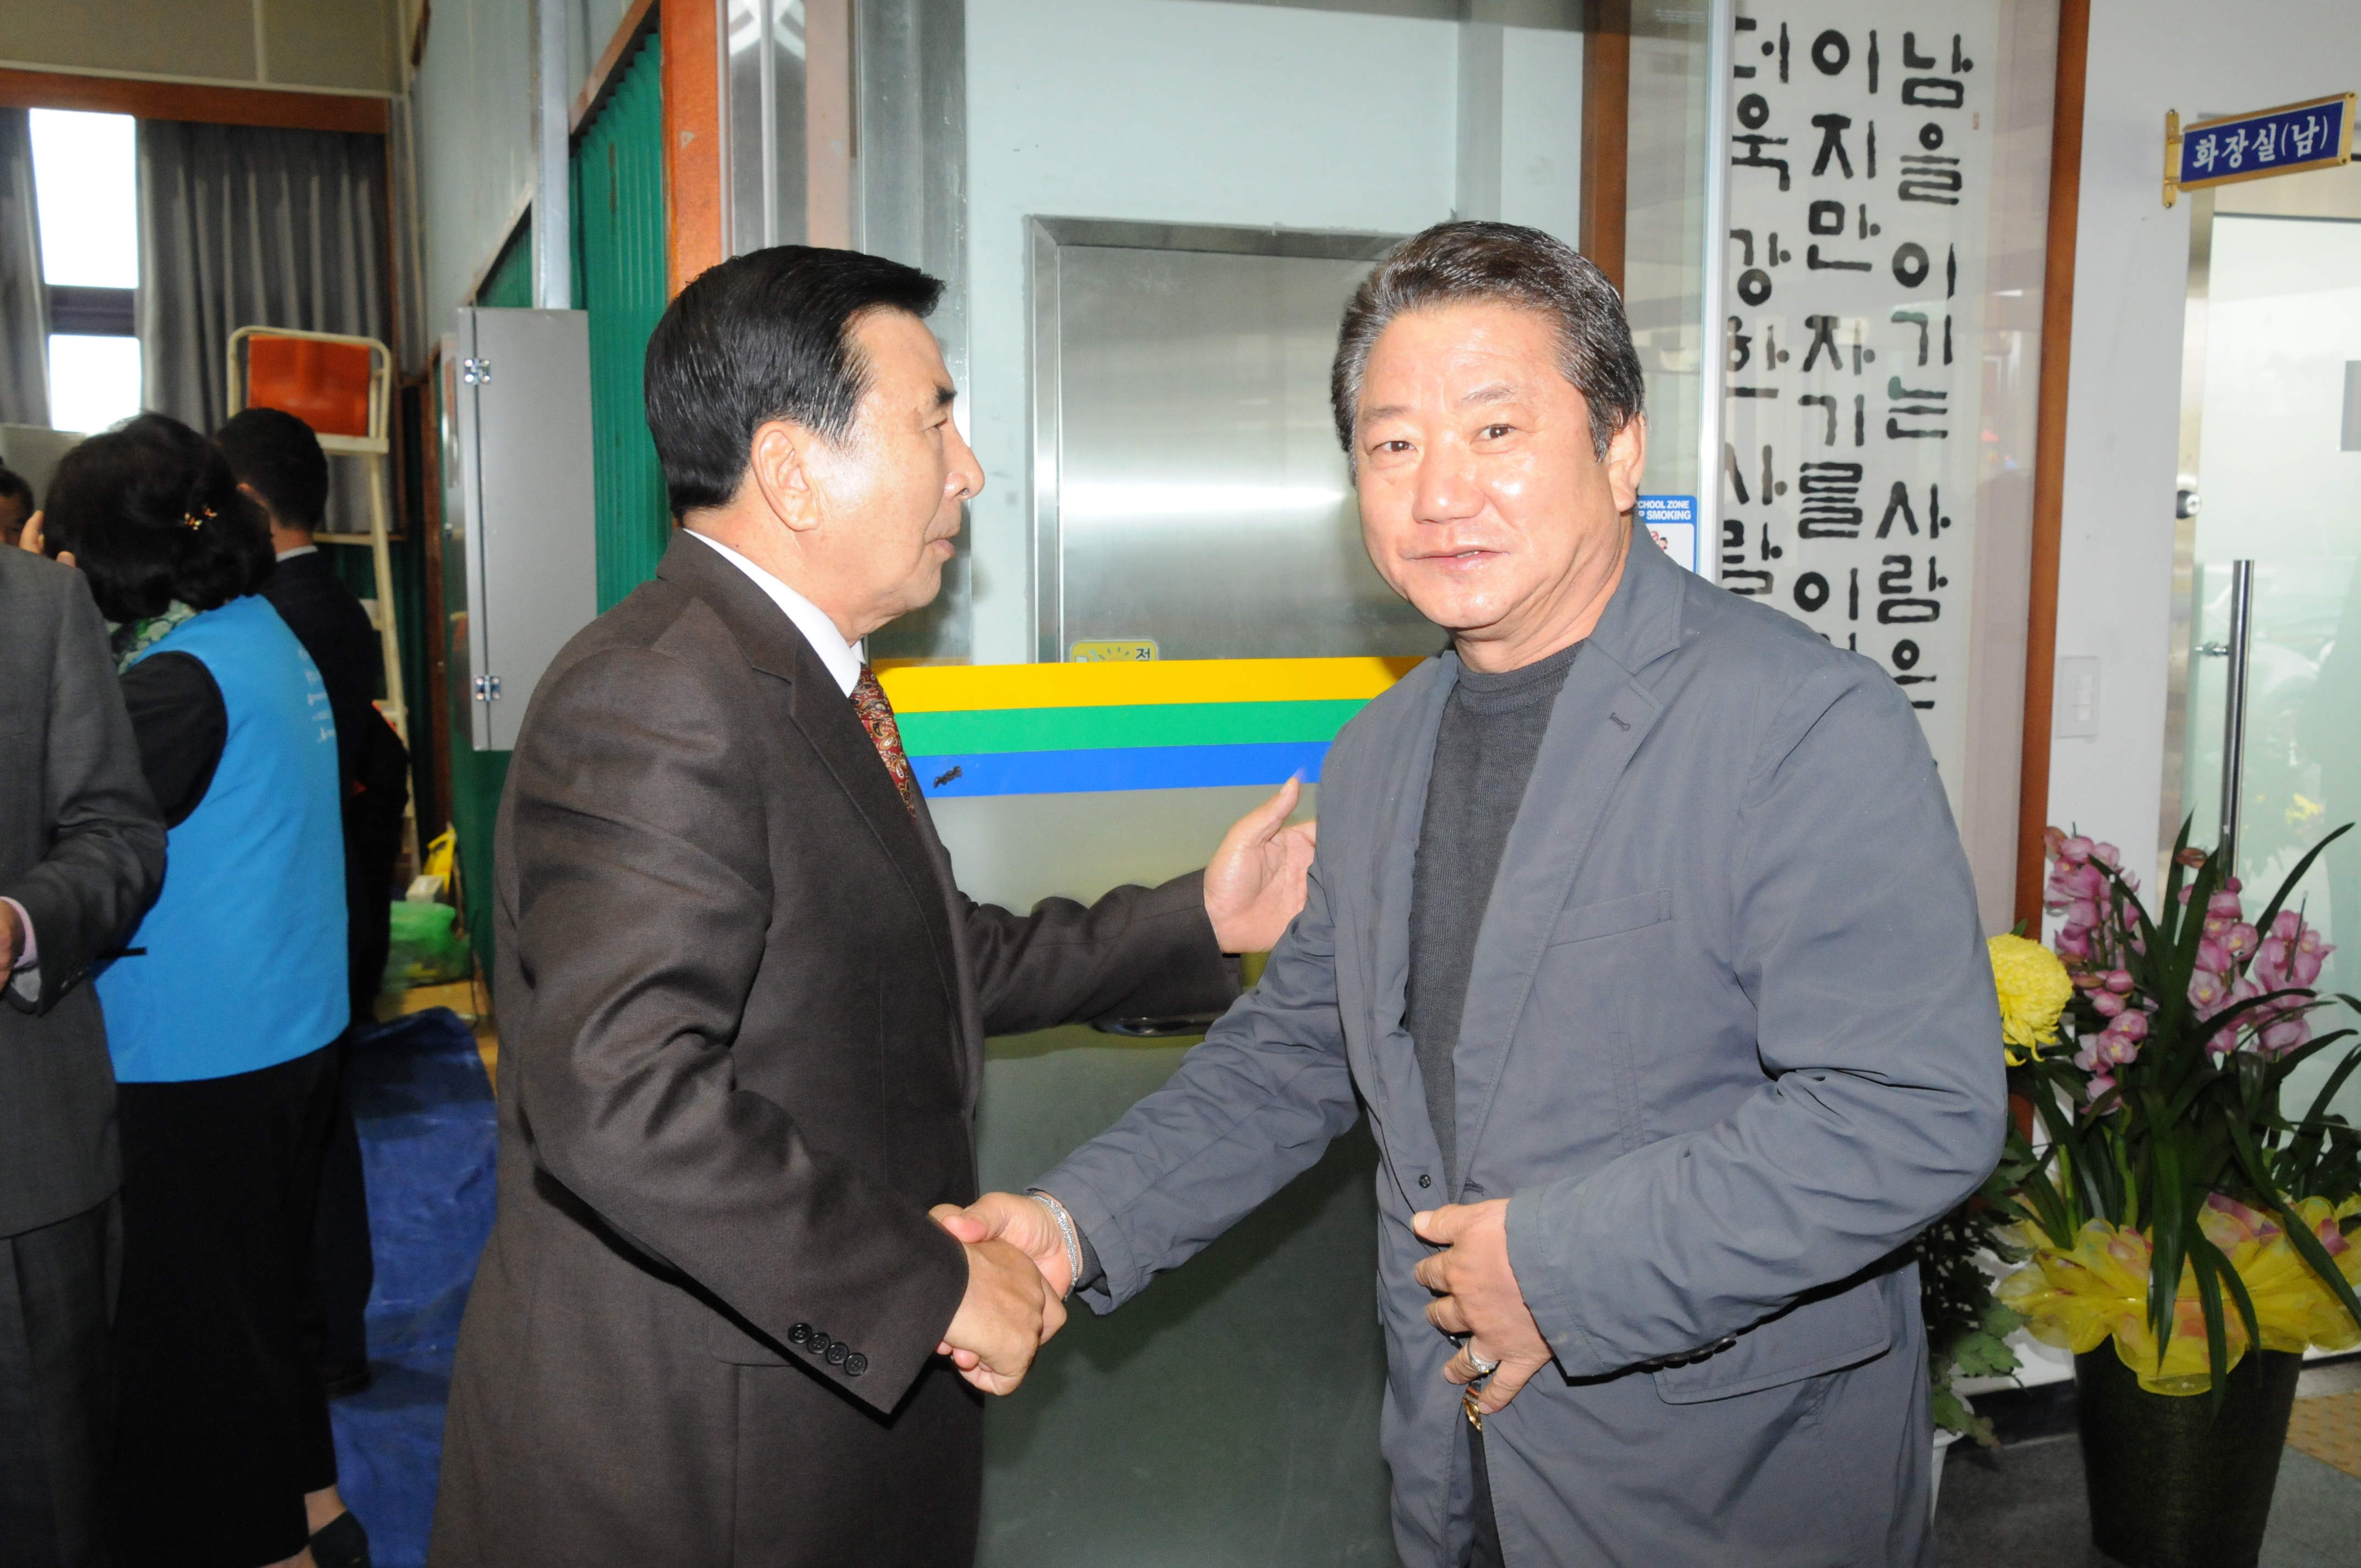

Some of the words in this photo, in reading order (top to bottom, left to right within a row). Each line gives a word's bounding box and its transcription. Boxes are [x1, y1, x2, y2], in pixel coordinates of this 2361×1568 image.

[1807, 29, 1881, 272] 이지만
[1898, 31, 1973, 205] 남을
[2193, 115, 2329, 172] 화장실(남)
[1798, 314, 1875, 540] 자기를
[1886, 241, 1957, 439] 이기는
[1638, 500, 1666, 509] CHOOL
[1667, 500, 1690, 509] ZONE
[1646, 510, 1691, 520] SMOKING
[1875, 481, 1951, 710] 사람은
